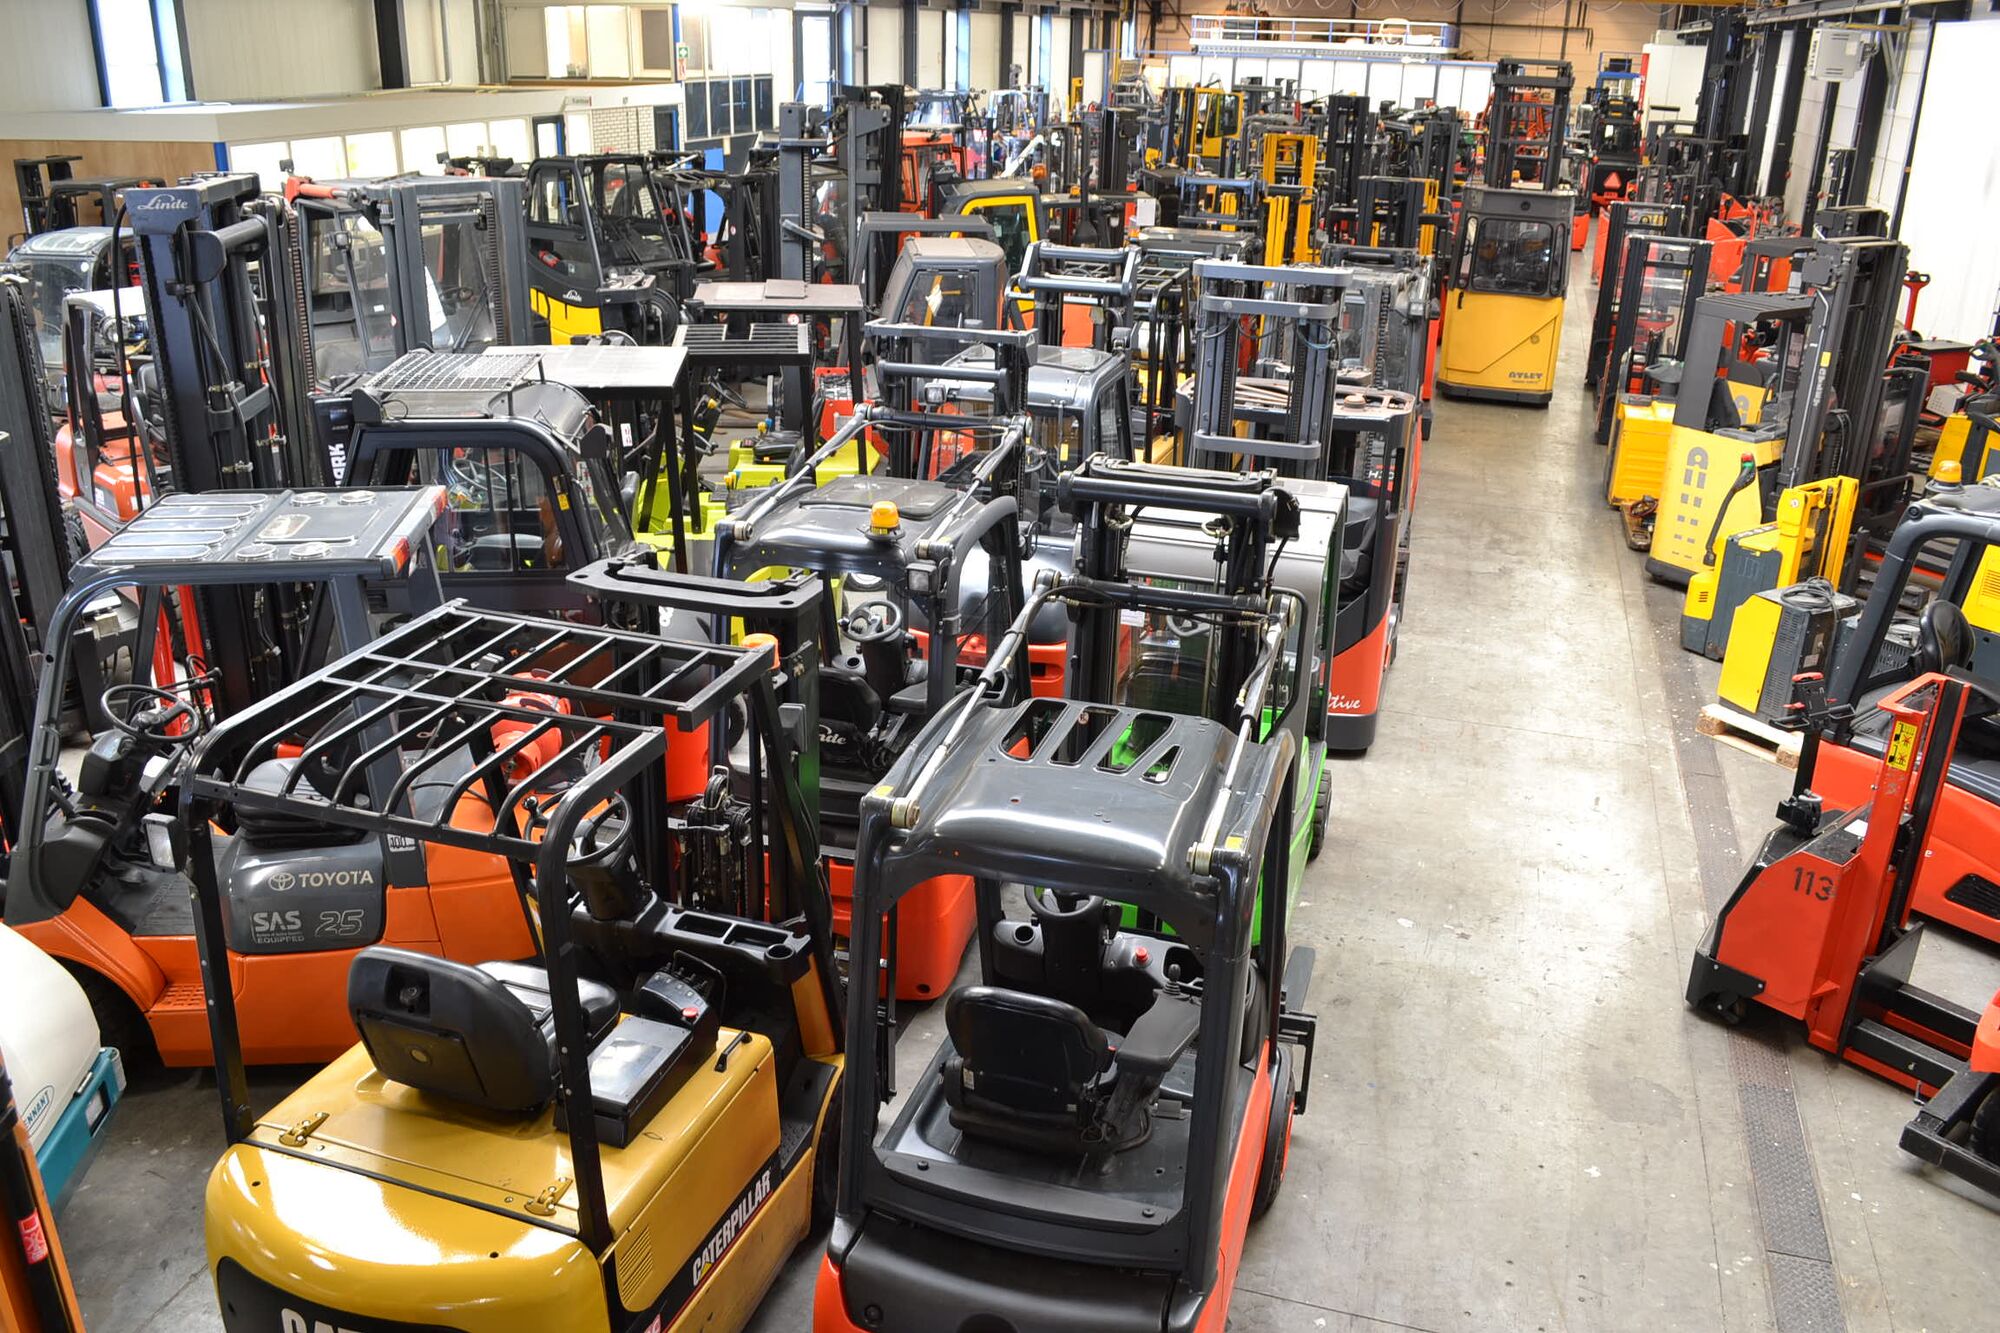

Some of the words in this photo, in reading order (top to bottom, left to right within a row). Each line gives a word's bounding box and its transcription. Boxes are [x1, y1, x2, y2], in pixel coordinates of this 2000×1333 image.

[137, 193, 189, 210] Linde
[299, 870, 374, 888] TOYOTA
[1794, 866, 1834, 901] 113
[253, 910, 302, 932] SAS
[314, 908, 365, 938] 25
[692, 1169, 772, 1287] CATERPILLAR
